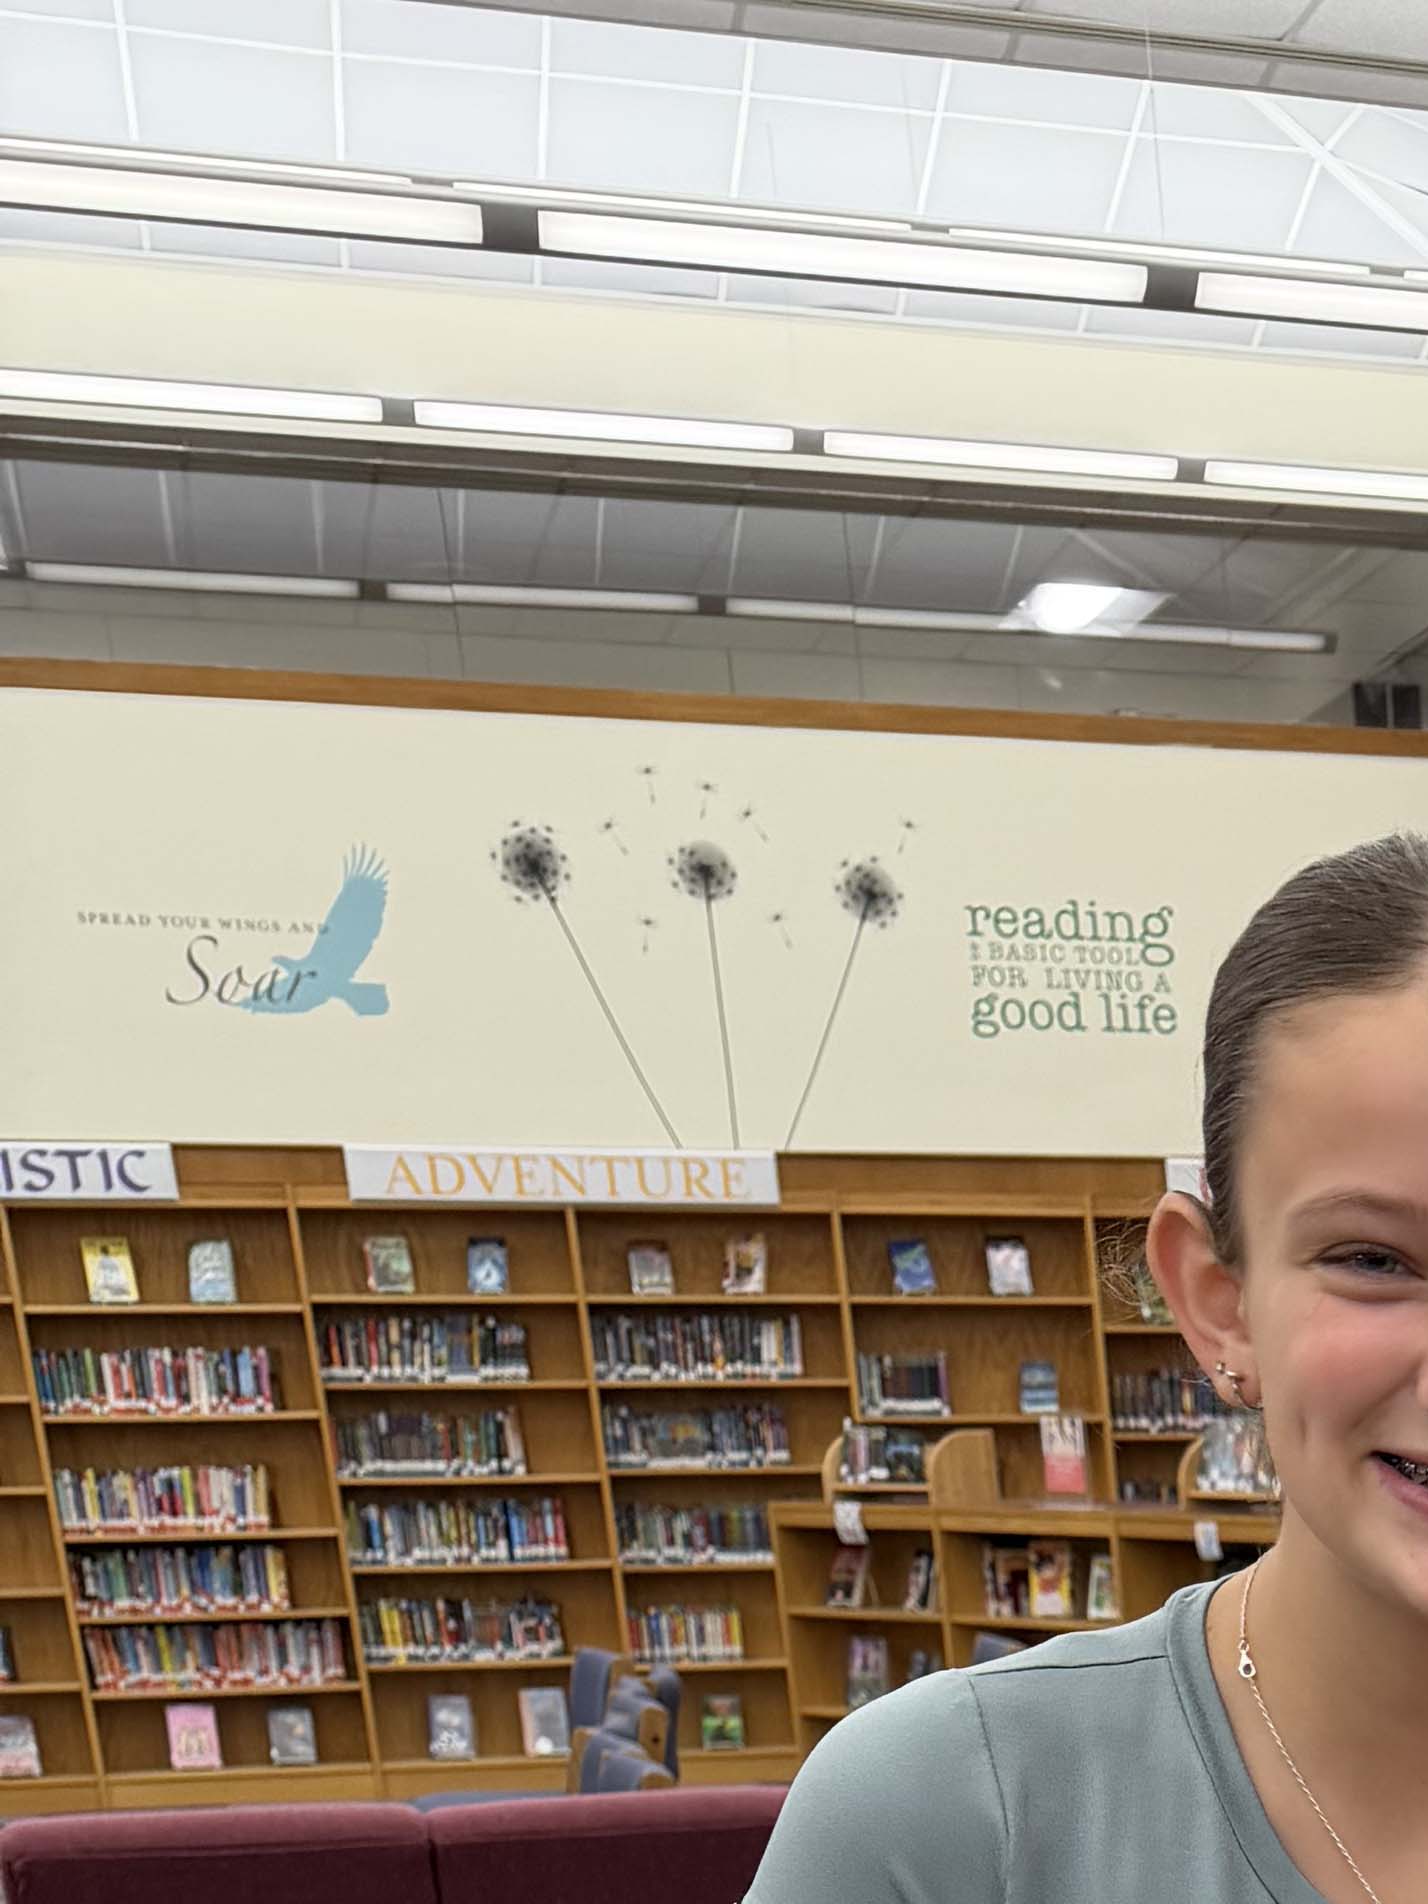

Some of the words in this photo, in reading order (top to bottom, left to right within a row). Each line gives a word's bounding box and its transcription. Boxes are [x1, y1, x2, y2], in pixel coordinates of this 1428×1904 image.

[77, 911, 151, 927] SPREAD
[158, 915, 210, 930] YOUR
[217, 916, 281, 933] WINGS
[288, 921, 330, 935] AND
[964, 899, 1174, 967] reading
[165, 935, 318, 1006] Soar
[988, 942, 1066, 964] BASIC
[1073, 946, 1141, 966] TOOL
[971, 965, 1028, 988] FOR
[1045, 967, 1143, 991] LIVING
[1153, 972, 1172, 993] A
[971, 992, 1087, 1038] good
[1099, 992, 1179, 1035] life
[386, 1152, 754, 1202] ADVENTURE
